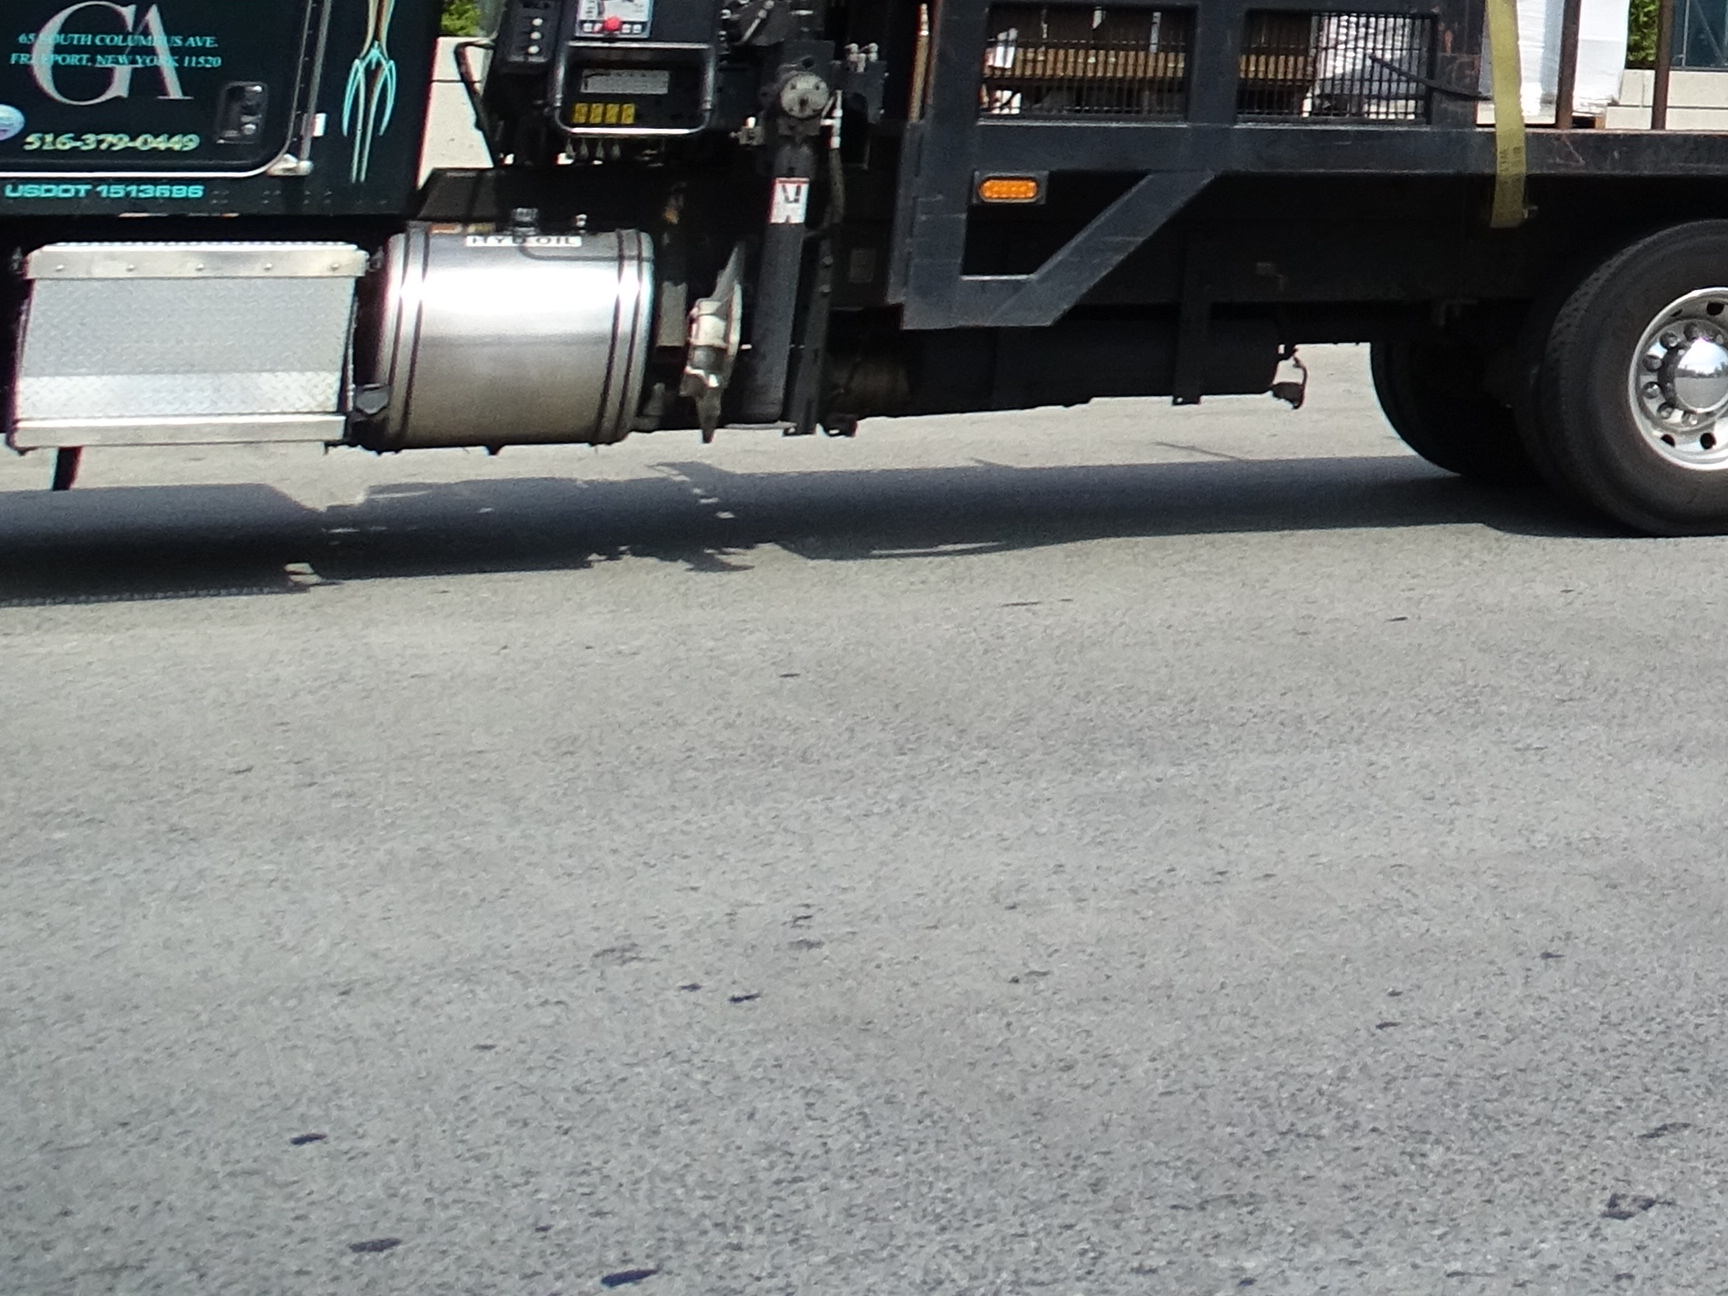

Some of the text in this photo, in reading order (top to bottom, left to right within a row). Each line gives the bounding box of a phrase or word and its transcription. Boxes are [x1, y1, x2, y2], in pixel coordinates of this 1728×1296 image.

[43, 33, 92, 45] OUTH
[94, 33, 183, 47] COLUMUS
[95, 53, 133, 67] NEW
[134, 54, 179, 68] YOK
[23, 132, 200, 151] 516-379-0449
[4, 183, 93, 198] USDOT
[536, 236, 576, 246] OIL
